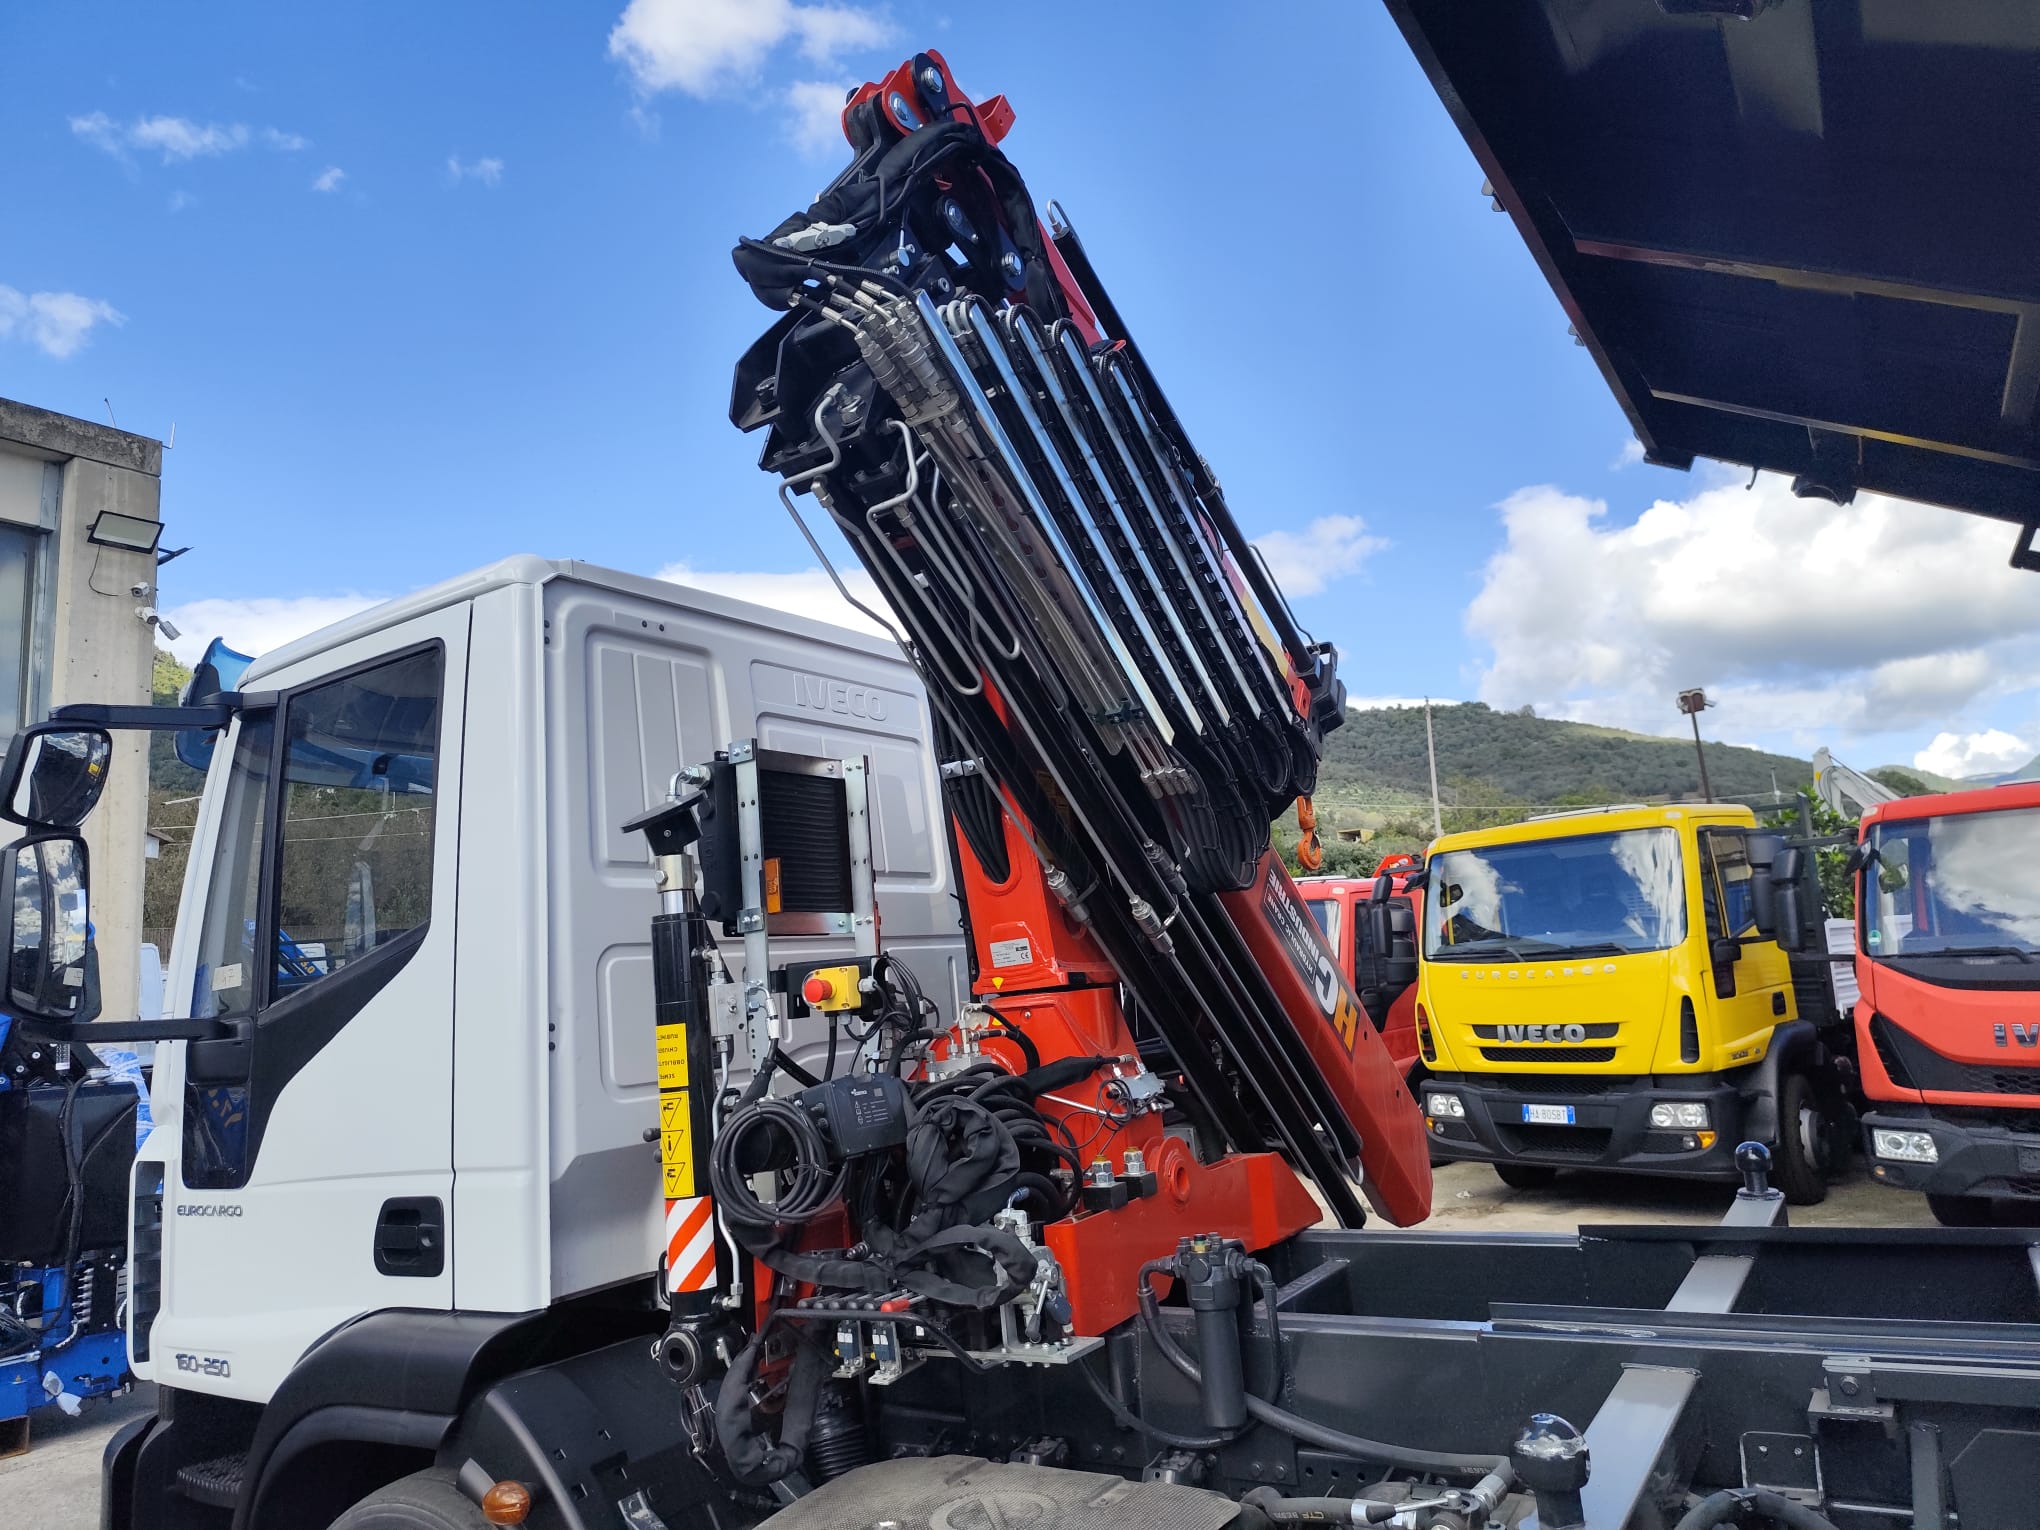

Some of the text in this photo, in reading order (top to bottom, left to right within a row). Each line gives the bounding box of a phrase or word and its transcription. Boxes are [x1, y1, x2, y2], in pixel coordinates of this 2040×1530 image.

[793, 673, 888, 722] IVECO
[1460, 963, 1617, 979] EUROCARGO
[1496, 1023, 1586, 1043] IVECO
[177, 1204, 243, 1217] EUROCARGO
